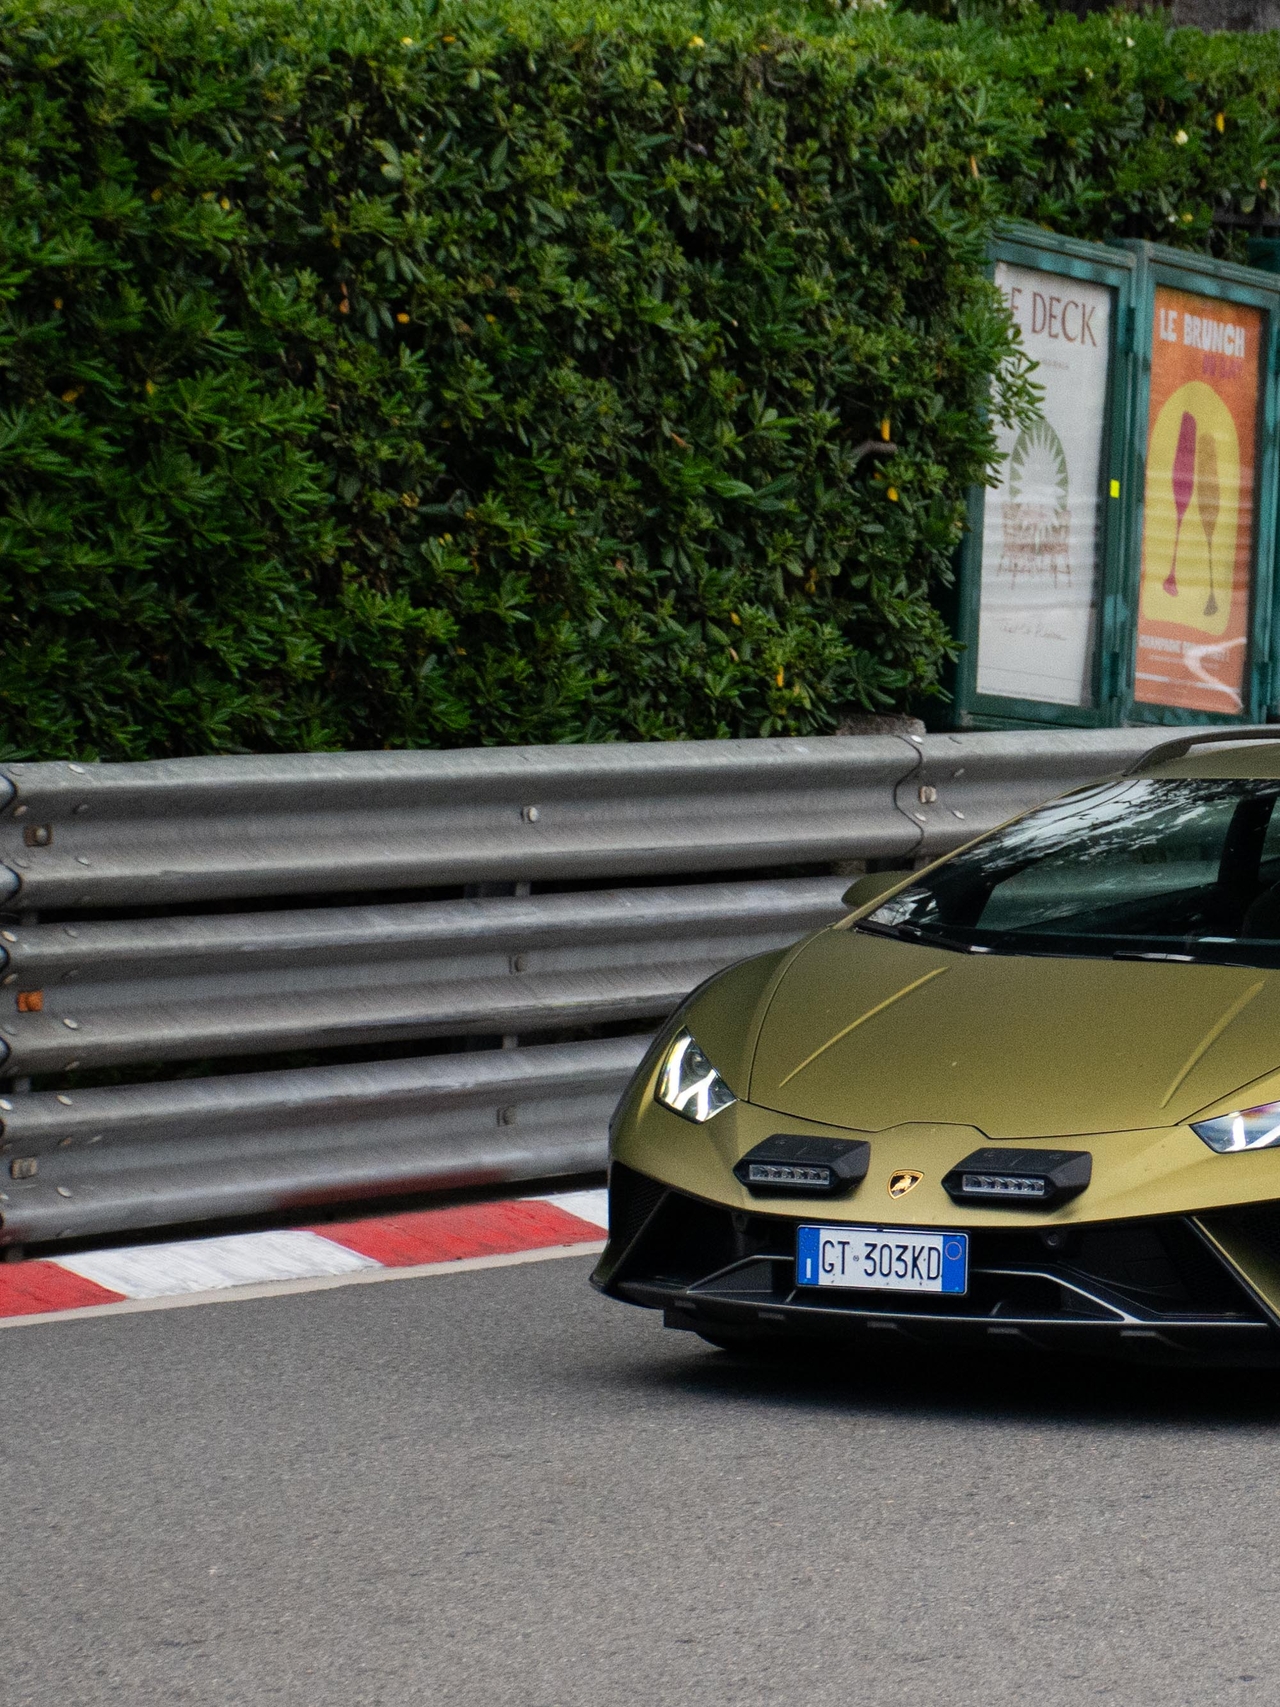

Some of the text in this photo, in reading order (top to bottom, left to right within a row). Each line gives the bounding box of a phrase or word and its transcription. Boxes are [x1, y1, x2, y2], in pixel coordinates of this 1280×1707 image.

[1031, 290, 1097, 347] DECK
[1160, 308, 1246, 359] LE BRUNCH
[821, 1239, 941, 1280] GT 303KD
